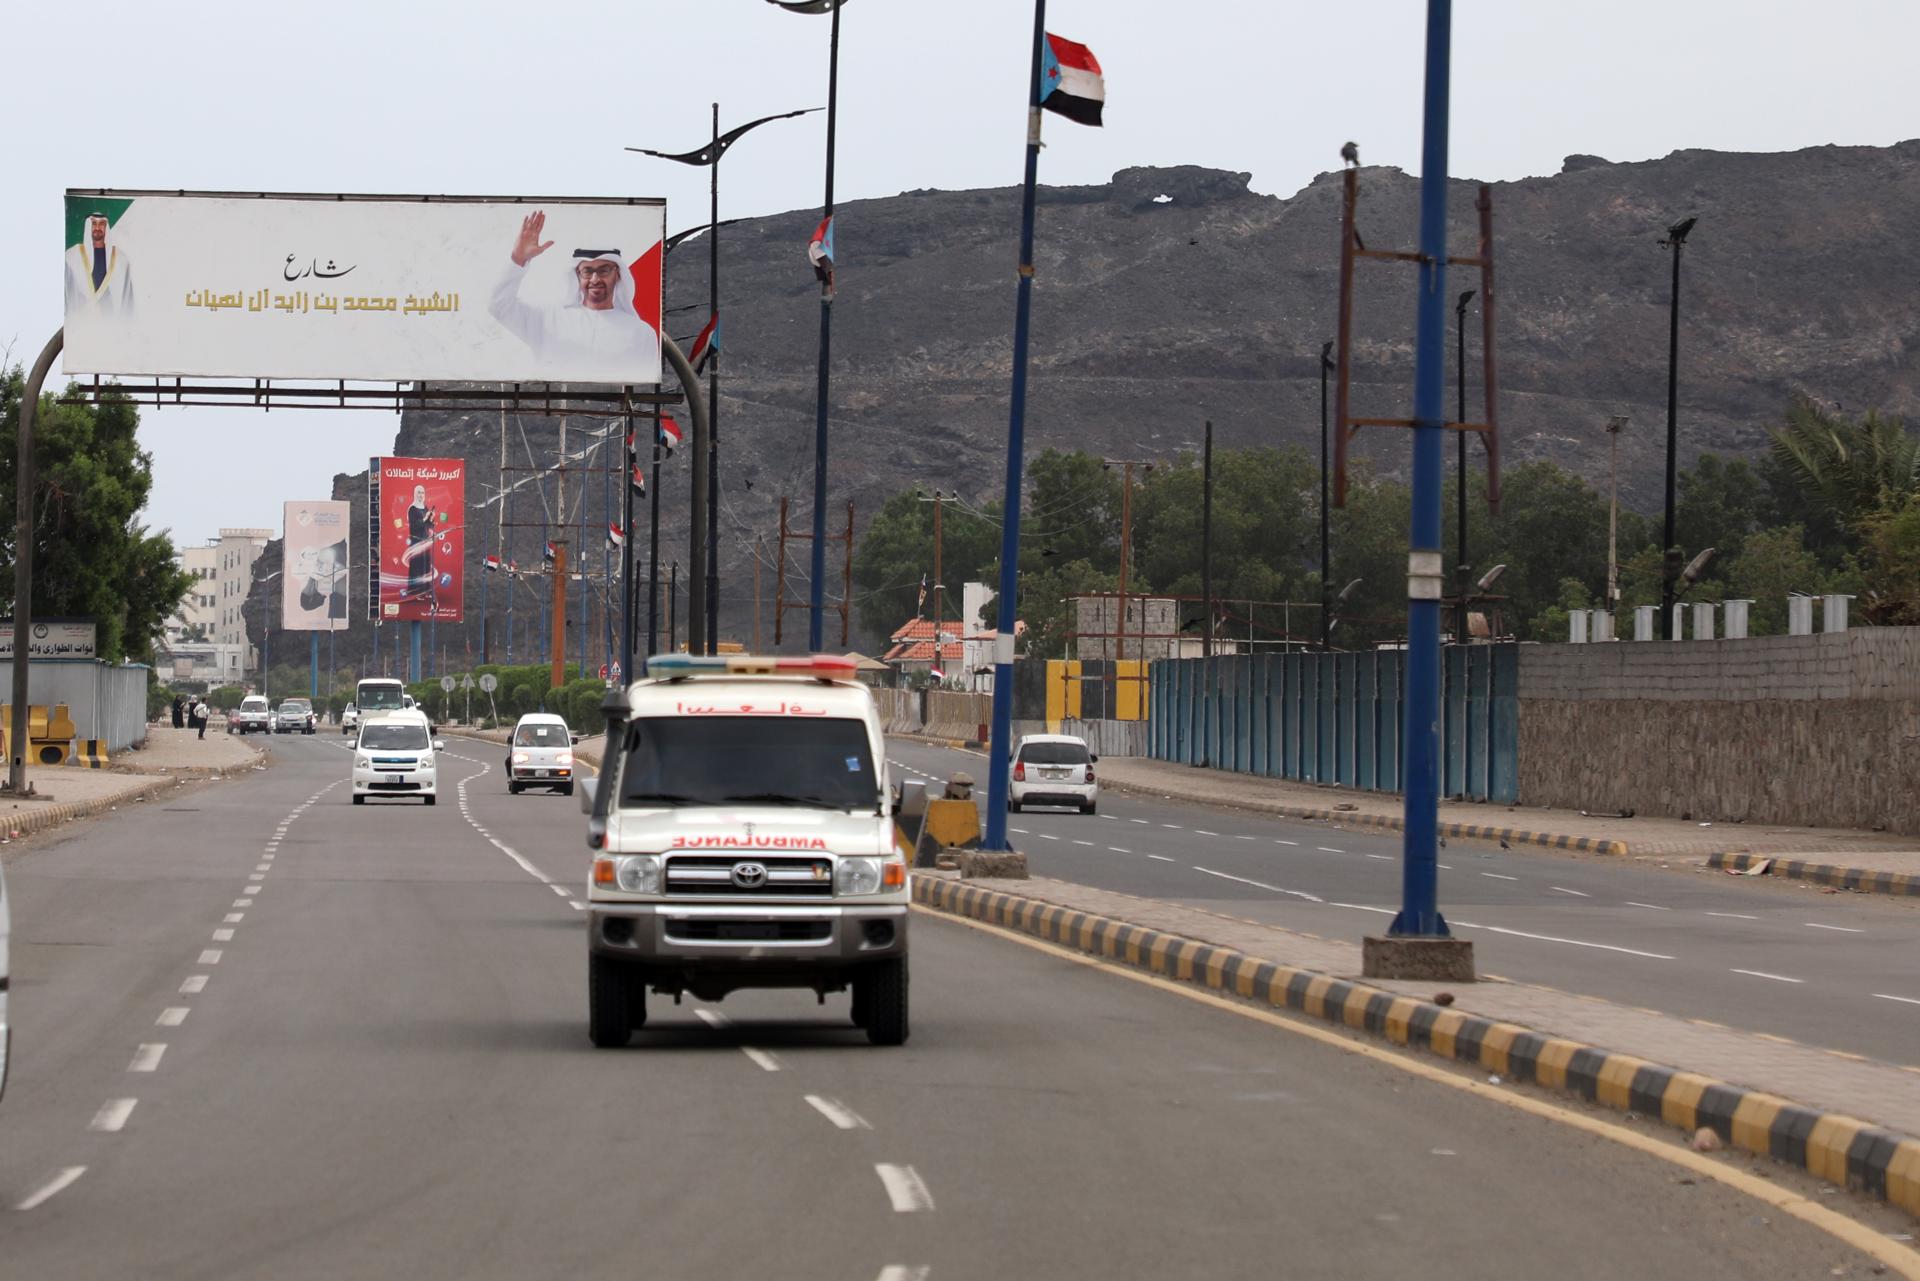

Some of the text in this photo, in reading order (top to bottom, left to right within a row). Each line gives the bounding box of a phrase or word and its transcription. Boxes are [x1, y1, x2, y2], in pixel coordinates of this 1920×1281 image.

[283, 252, 358, 282] شارع
[185, 287, 460, 316] الشيخ محمد بن زايد آل نهيان
[416, 467, 438, 480] شبكة
